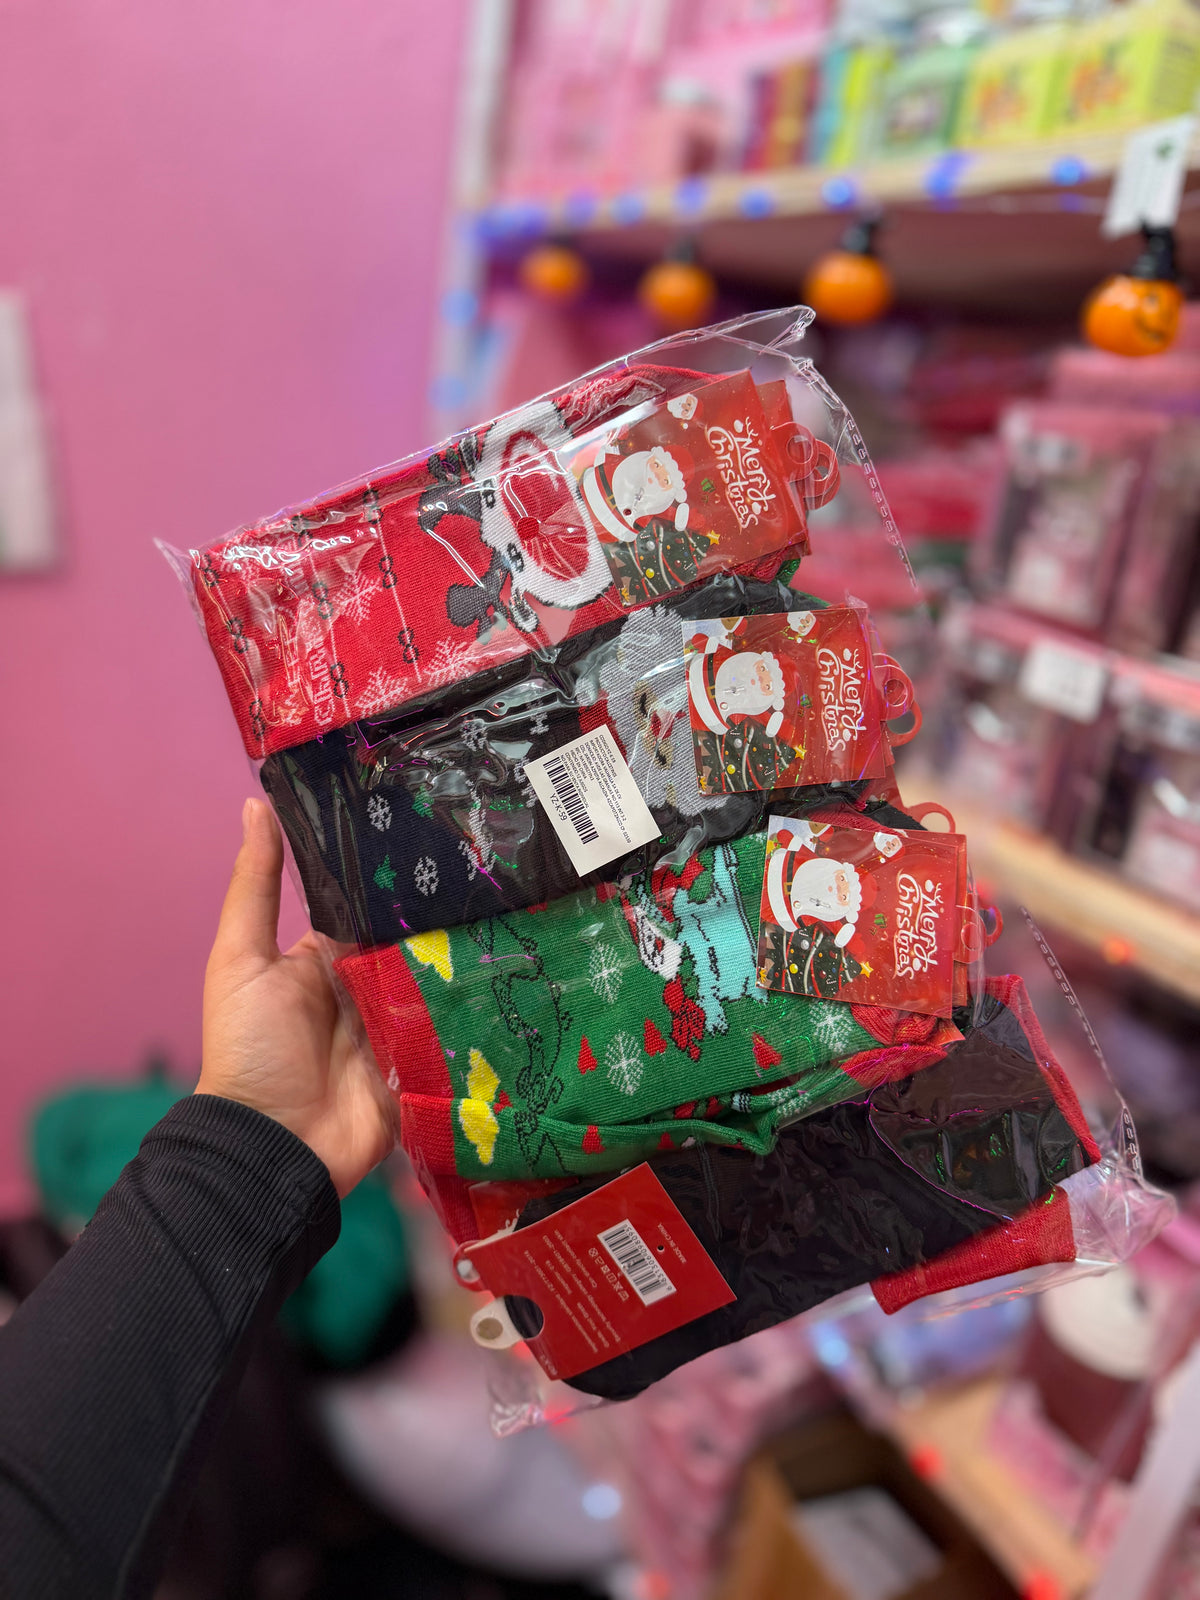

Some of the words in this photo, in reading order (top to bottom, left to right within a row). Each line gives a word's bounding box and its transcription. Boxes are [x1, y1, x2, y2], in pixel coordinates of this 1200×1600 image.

[705, 425, 759, 529] Christmas
[733, 430, 777, 512] Merry
[816, 648, 846, 752] Christmas
[838, 657, 867, 741] Merry
[548, 792, 568, 821] YZ-K-59
[895, 873, 920, 980] Christmas
[914, 886, 941, 973] Merry
[656, 1222, 672, 1241] CHINA
[668, 1239, 676, 1247] IN
[672, 1245, 687, 1264] MADE
